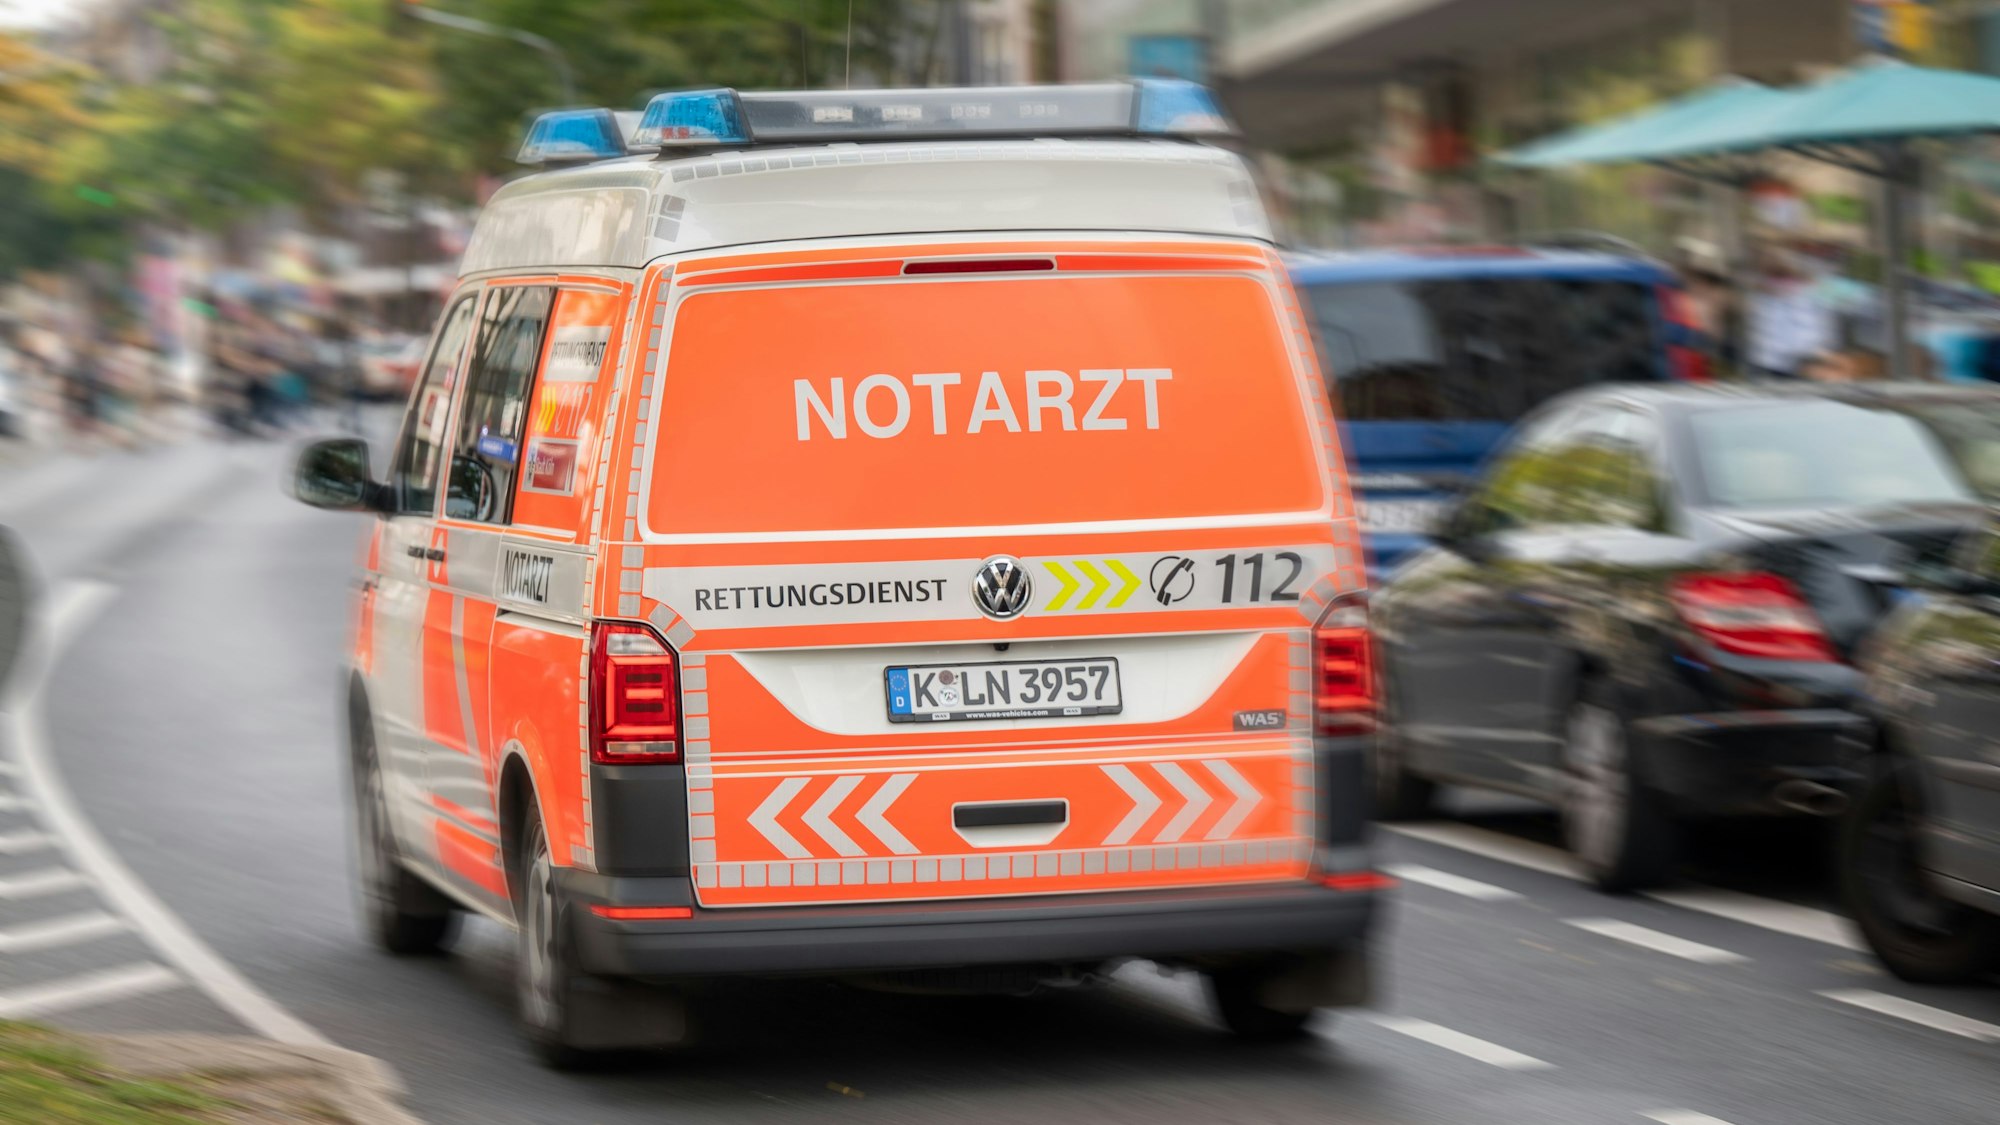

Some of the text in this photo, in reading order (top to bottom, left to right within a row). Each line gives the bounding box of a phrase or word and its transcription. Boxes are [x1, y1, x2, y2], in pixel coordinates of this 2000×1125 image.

[794, 368, 1173, 440] NOTARZT
[502, 549, 553, 603] NOTARZT
[1215, 552, 1303, 604] 112
[695, 579, 947, 611] RETTUNGSDIENST
[896, 697, 905, 707] D
[913, 666, 1110, 707] K LN 3957
[966, 709, 1049, 719] www.was-vehicles.com
[1240, 712, 1279, 726] WAS
